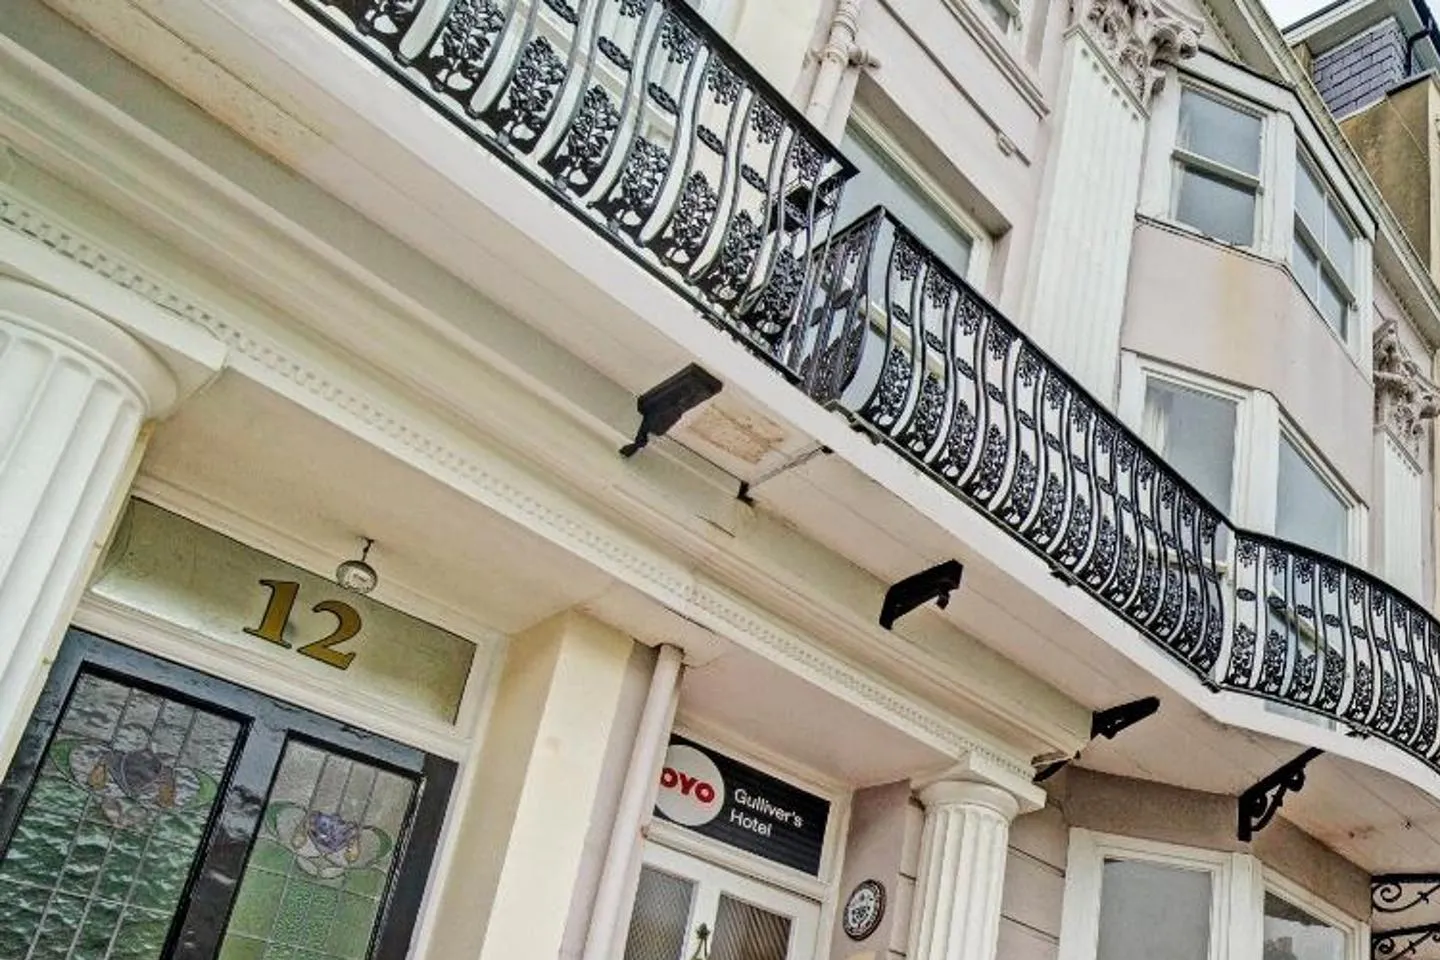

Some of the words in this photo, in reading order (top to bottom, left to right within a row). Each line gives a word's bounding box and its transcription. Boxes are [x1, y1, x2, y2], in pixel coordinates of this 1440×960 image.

[243, 579, 362, 671] 12
[660, 767, 715, 803] OYO
[730, 808, 773, 837] Hotel
[734, 788, 804, 828] Gulliver's
